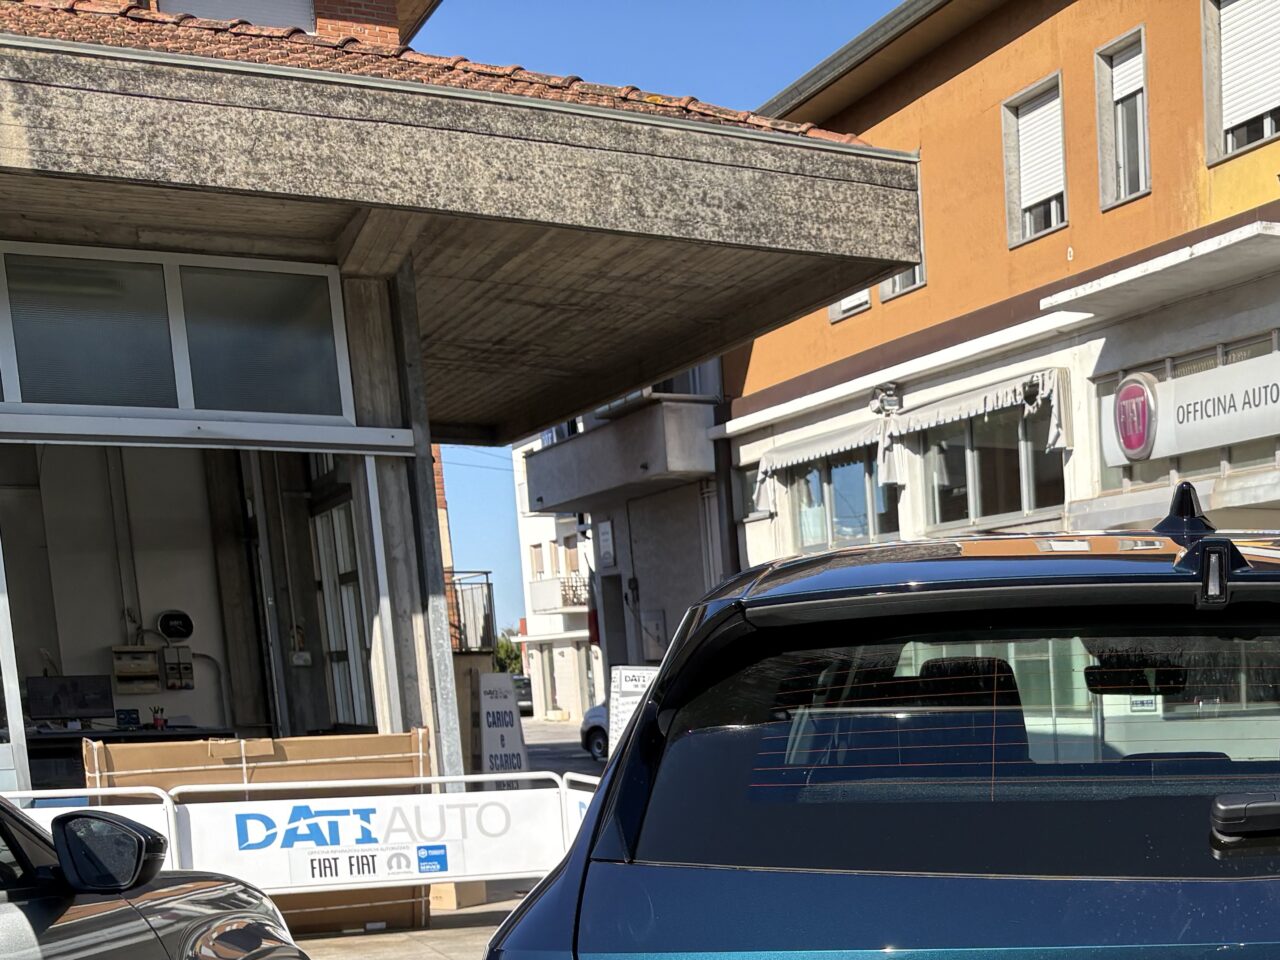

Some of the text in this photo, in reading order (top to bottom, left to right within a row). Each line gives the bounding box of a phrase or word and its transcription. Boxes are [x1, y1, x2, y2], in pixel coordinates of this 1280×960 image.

[1176, 395, 1238, 425] OFFICINA
[486, 711, 514, 728] CARICO
[500, 734, 505, 748] e
[489, 752, 522, 771] SCARICO
[310, 854, 377, 878] FIAT FIAT
